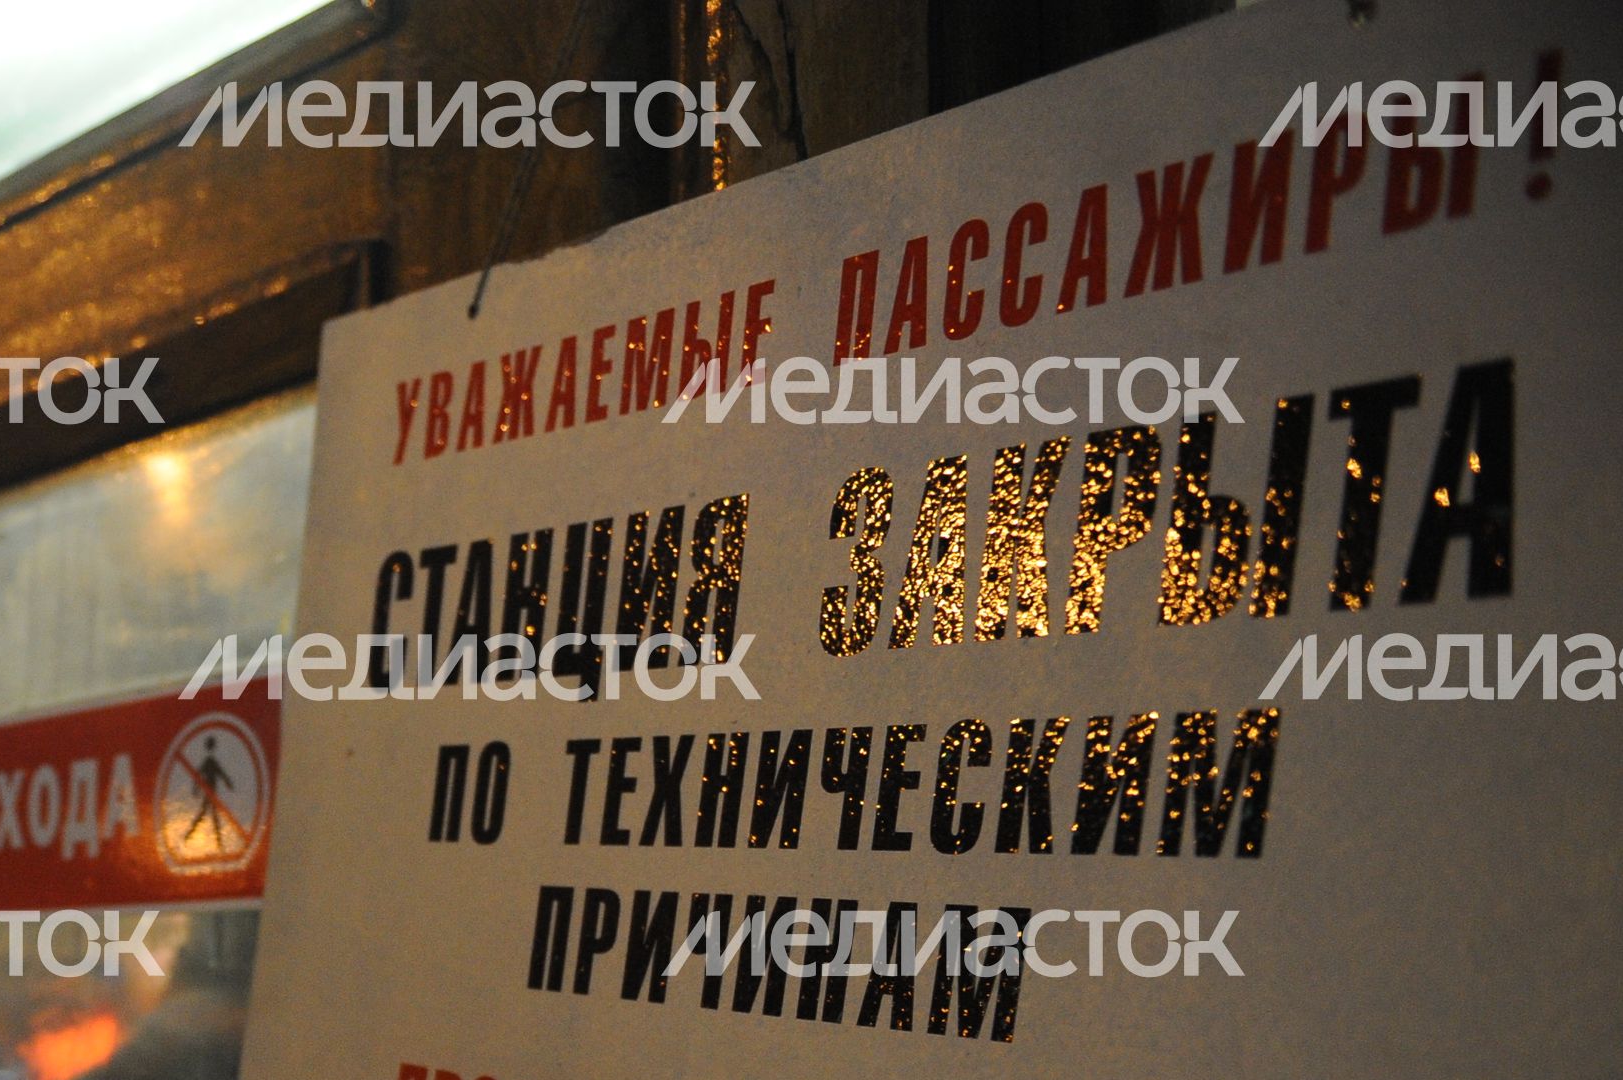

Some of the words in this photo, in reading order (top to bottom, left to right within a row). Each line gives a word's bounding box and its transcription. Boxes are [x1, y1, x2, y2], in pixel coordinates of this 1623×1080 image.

[392, 279, 775, 465] УВАЖАЕМЫЕ
[368, 493, 750, 702] СТАНЦИЯ
[819, 357, 1515, 657] ЗАКРЫТА
[429, 741, 509, 844] ПО
[565, 706, 1283, 860] ТЕХНИЧЕСКИМ
[527, 885, 1032, 1043] ПРИЧИНАМ
